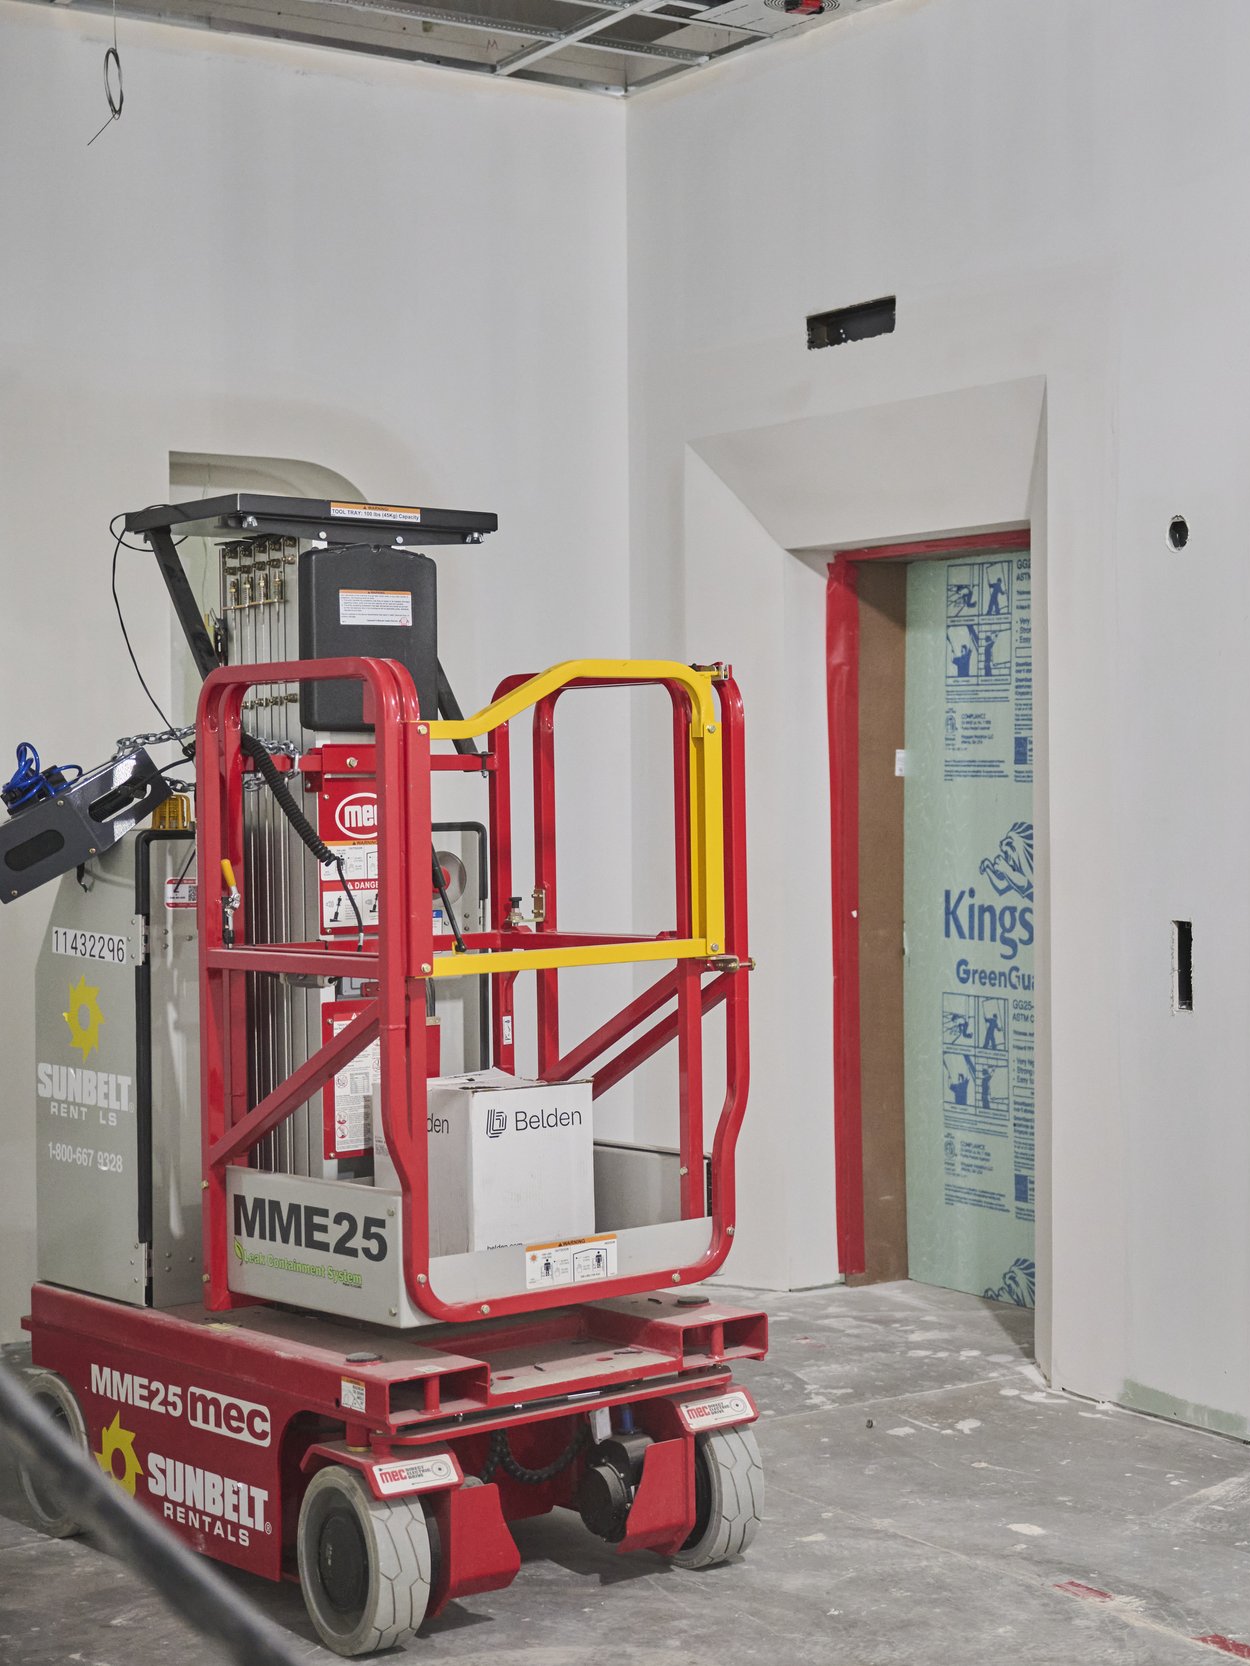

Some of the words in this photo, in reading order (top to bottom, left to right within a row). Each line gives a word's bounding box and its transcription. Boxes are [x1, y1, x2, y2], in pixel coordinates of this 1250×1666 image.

[944, 887, 1034, 960] Kings
[54, 930, 125, 963] 11432296
[956, 958, 1034, 991] GreenGu
[50, 1102, 118, 1126] RENTLS
[514, 1108, 582, 1131] Belden
[233, 1194, 388, 1262] MME25
[244, 1249, 266, 1266] Leak
[268, 1254, 326, 1278] Containment
[327, 1266, 362, 1284] System
[90, 1363, 183, 1418] MME25
[189, 1391, 270, 1441] mec
[687, 1405, 710, 1420] mec
[380, 1469, 408, 1484] mec
[164, 1502, 250, 1546] RENTALS
